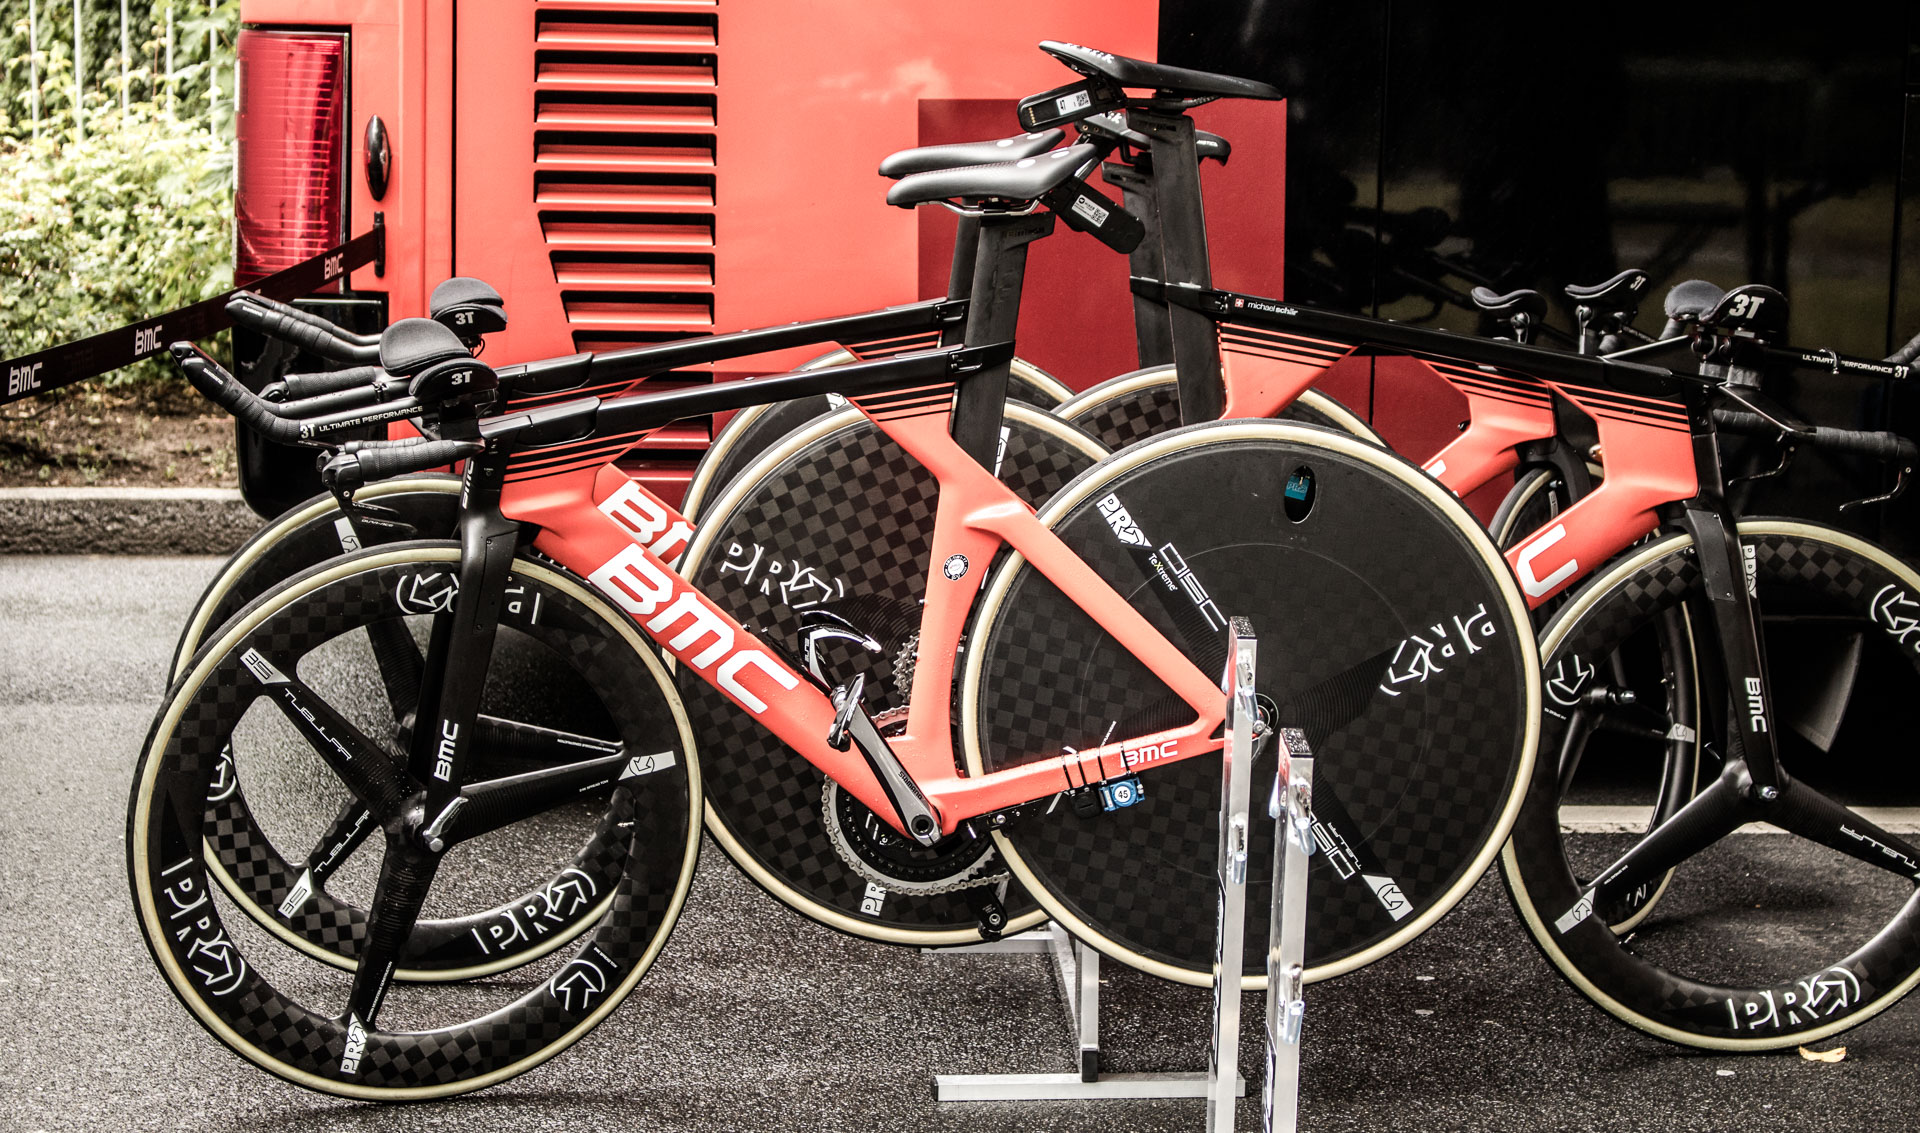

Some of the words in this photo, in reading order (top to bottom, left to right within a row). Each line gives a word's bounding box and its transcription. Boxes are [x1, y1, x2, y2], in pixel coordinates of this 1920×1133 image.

[324, 253, 344, 280] BMC
[1629, 275, 1647, 291] 3T
[455, 311, 474, 325] 3T
[1247, 301, 1275, 312] michael
[1729, 293, 1766, 319] 3T
[134, 324, 163, 356] BMC
[8, 361, 43, 397] BMC
[451, 370, 473, 386] 3T
[1894, 365, 1910, 379] 3T
[299, 423, 316, 439] 3T
[318, 418, 361, 433] ULTIMATE
[362, 405, 423, 423] PERFORMANCE
[1158, 541, 1229, 633] DISC
[587, 542, 800, 715] BMC
[1744, 676, 1768, 733] BMC
[284, 687, 353, 761] TUBULAR
[432, 719, 460, 782] BMC
[1120, 739, 1179, 769] BMC
[898, 770, 924, 801] SHIMANO
[1117, 789, 1129, 799] 45
